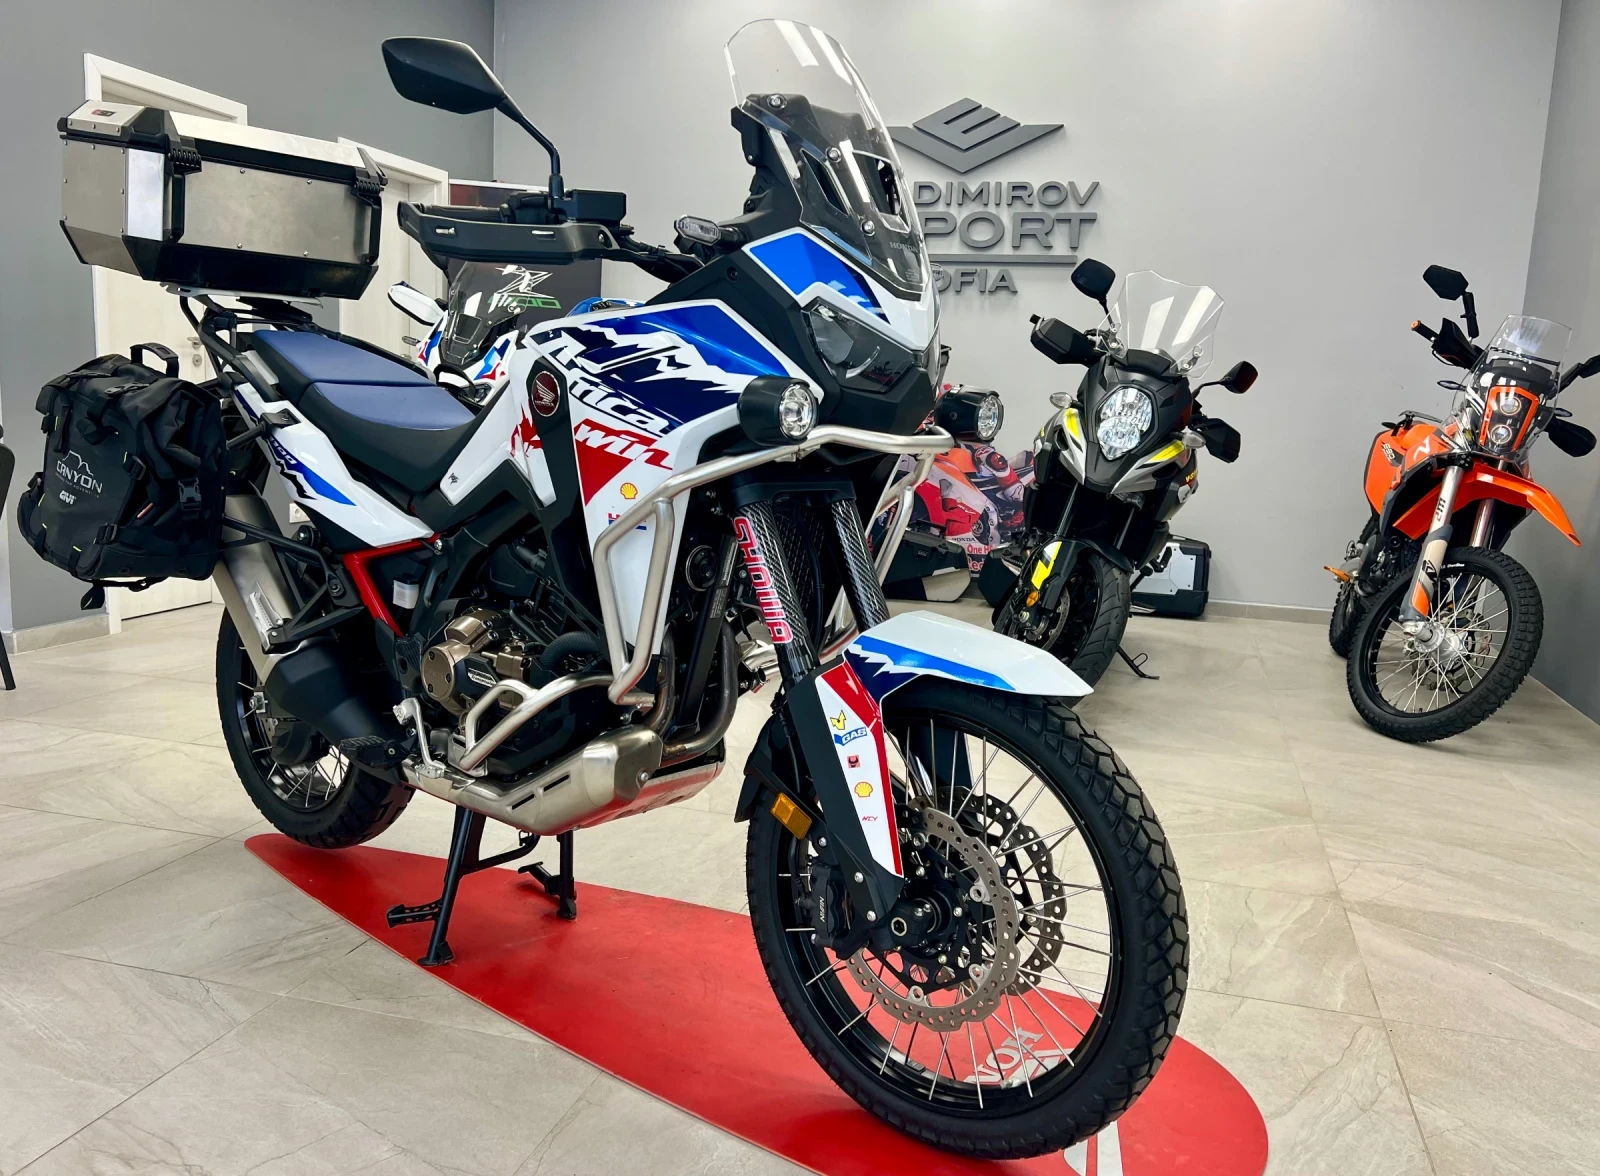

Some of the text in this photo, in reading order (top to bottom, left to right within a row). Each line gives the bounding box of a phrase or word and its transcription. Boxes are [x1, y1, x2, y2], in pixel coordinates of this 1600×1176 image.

[913, 180, 1100, 206] DIMIROV
[918, 210, 1098, 249] PORT
[932, 268, 1019, 293] OFIA
[56, 460, 103, 493] CANYON
[967, 543, 982, 554] One
[733, 516, 794, 644] SHOWA
